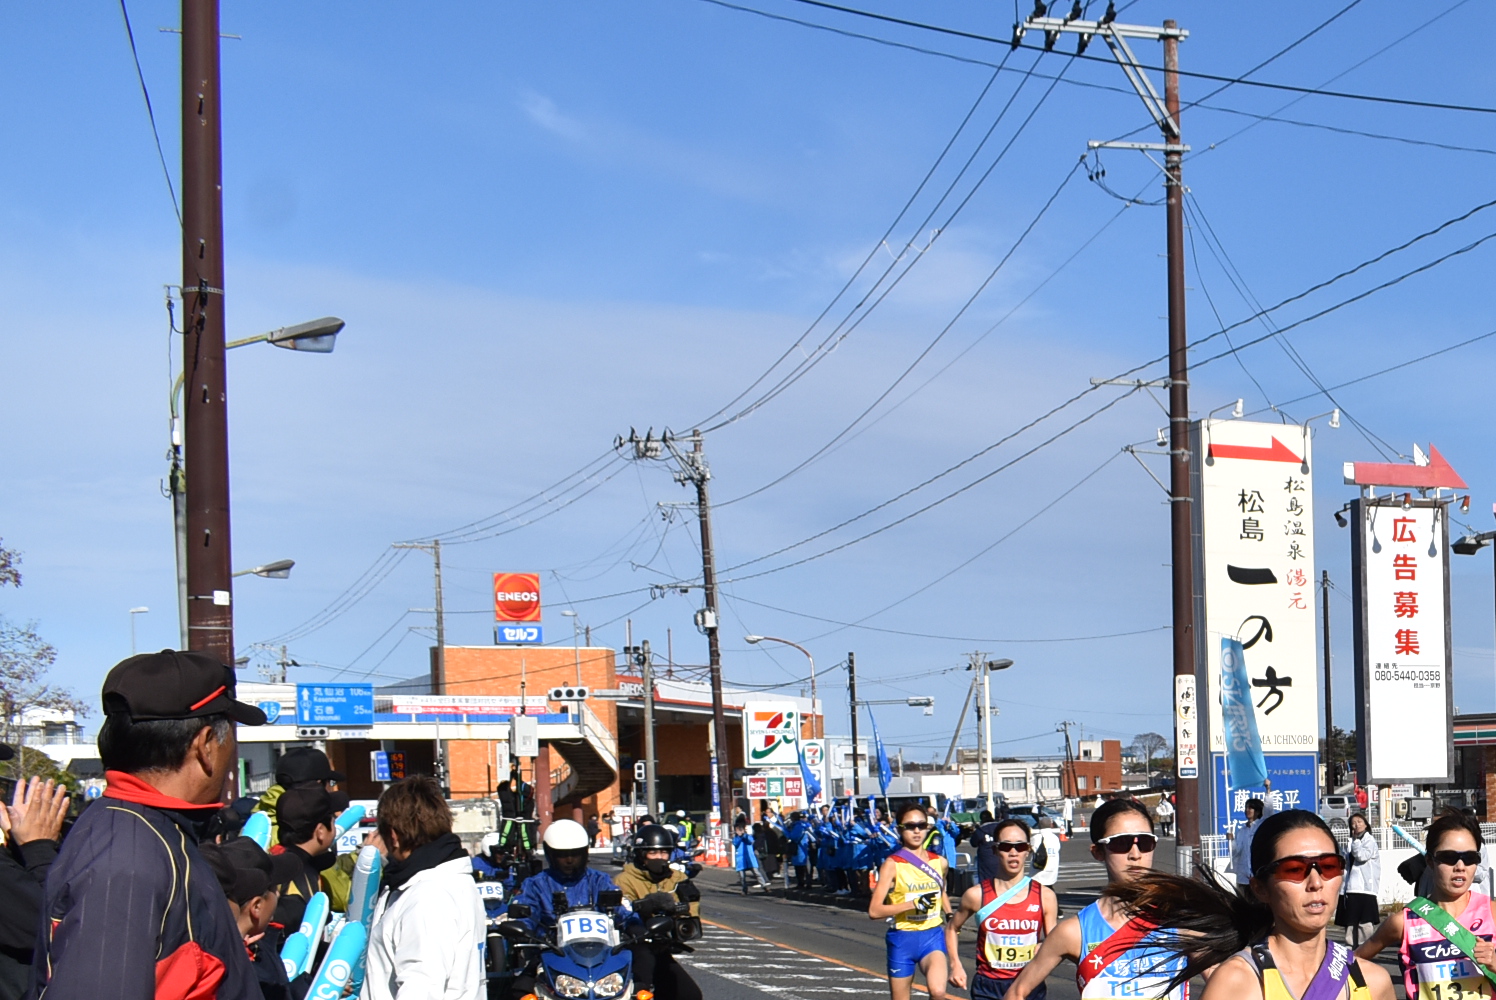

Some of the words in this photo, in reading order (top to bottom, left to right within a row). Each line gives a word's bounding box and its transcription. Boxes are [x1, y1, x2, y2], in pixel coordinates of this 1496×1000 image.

[1238, 488, 1265, 542] 松島
[1283, 476, 1306, 561] 松島温泉
[1286, 568, 1307, 610] 湯元
[1391, 516, 1420, 656] 広告募集
[496, 592, 539, 602] ENEOS
[503, 627, 539, 641] セルフ
[1374, 670, 1441, 682] 080-5440-0358
[1274, 734, 1314, 745] ICHINOBO
[749, 780, 767, 794] たばこ
[769, 780, 782, 794] 酒
[785, 780, 801, 789] 銀行
[342, 835, 358, 847] 26
[479, 884, 504, 896] TBS
[562, 918, 608, 935] TBS
[984, 917, 1039, 931] Canon
[1001, 936, 1024, 946] TEL
[995, 947, 1032, 962] 19-1
[1436, 961, 1470, 980] TEL
[1107, 980, 1145, 997] TEL
